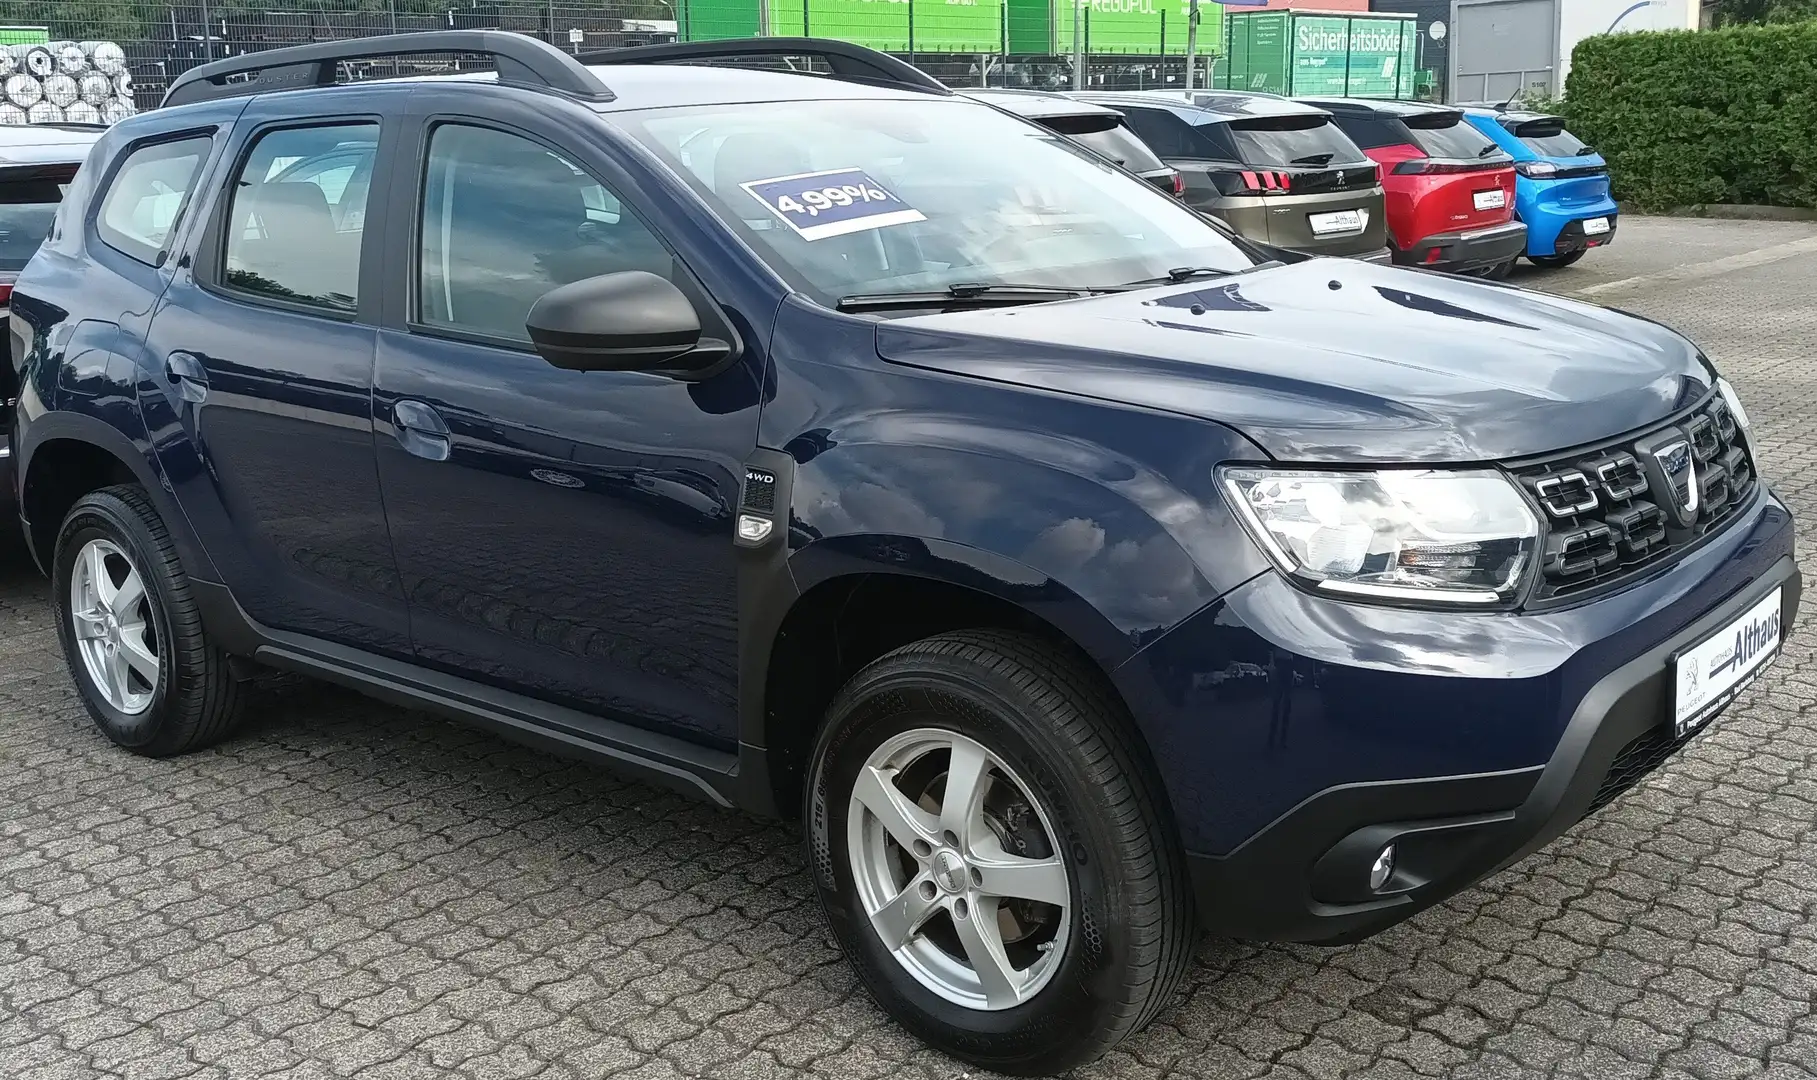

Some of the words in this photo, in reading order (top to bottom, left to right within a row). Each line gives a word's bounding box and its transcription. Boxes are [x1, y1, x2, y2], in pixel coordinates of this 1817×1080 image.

[1299, 26, 1408, 51] Sicherheitsböden
[259, 72, 309, 84] DUSTER
[778, 183, 887, 217] 4,99%
[745, 472, 774, 483] 4WD
[1732, 608, 1780, 673] Althaus
[1677, 692, 1706, 716] PEUGEOT
